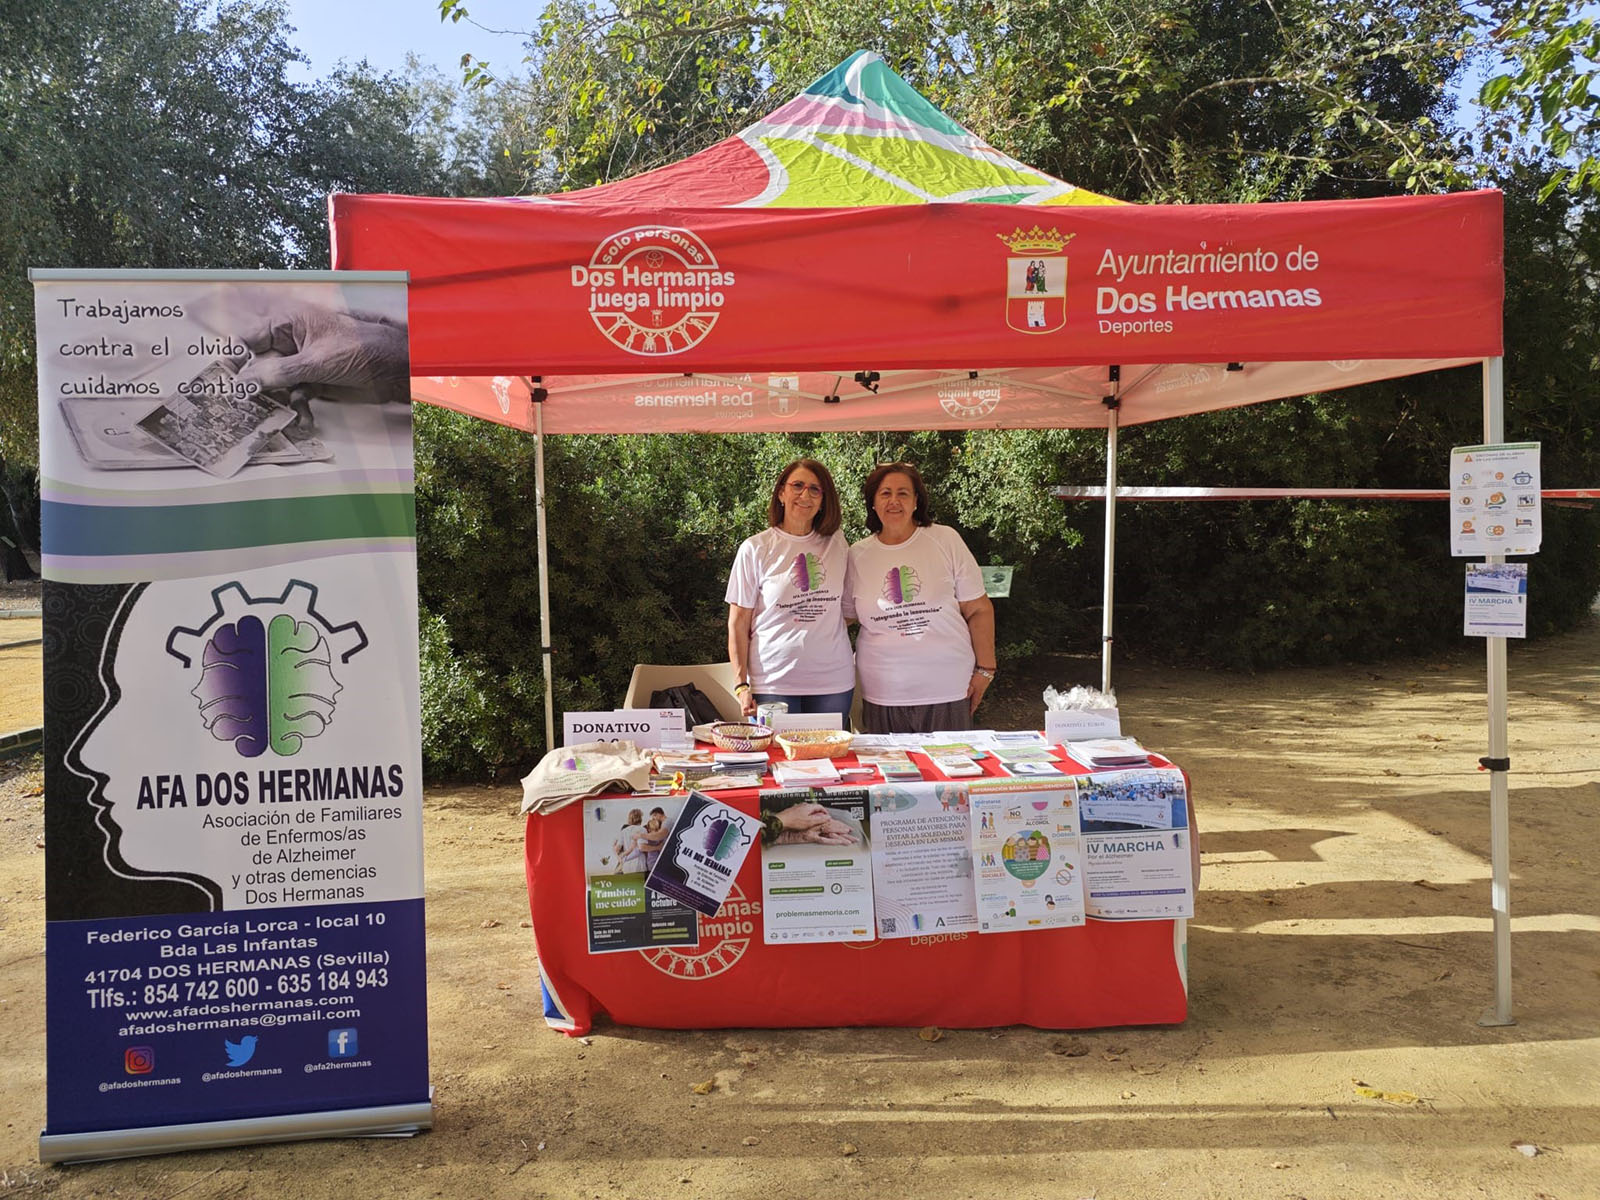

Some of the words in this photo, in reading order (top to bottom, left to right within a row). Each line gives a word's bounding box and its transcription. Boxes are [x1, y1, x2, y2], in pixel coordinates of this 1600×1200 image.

[602, 236, 632, 265] solo
[635, 229, 705, 264] personas
[1096, 246, 1278, 282] Ayuntamiento
[1286, 244, 1319, 271] de
[571, 265, 615, 287] Dos
[622, 265, 736, 287] Hermanas
[588, 287, 650, 312] juega
[657, 286, 725, 312] limpio
[1096, 287, 1157, 315] Dos
[1166, 285, 1323, 312] Hermanas
[57, 298, 184, 324] Trabajamos
[1099, 318, 1173, 336] Deportes
[60, 337, 134, 357] contra
[152, 336, 169, 356] el
[187, 336, 253, 360] olvido,
[60, 374, 160, 396] cuidamos
[177, 376, 258, 399] contigo
[573, 723, 651, 734] DONATIVO
[137, 775, 188, 810] AFA
[196, 771, 250, 807] DOS
[259, 764, 404, 804] HERMANAS
[202, 810, 290, 829] Asociación
[296, 808, 315, 824] de
[321, 806, 402, 823] Familiares
[880, 819, 917, 827] PROGRAMA
[928, 814, 961, 823] ATENCIÓN
[241, 831, 261, 846] de
[267, 826, 366, 845] Enfermos/as
[882, 826, 917, 834] PERSONAS
[886, 833, 910, 841] EVITAR
[252, 850, 273, 865] de
[276, 847, 356, 864] Alzheimer
[1087, 844, 1100, 854] IV
[1103, 840, 1165, 853] MARCHA
[682, 847, 693, 858] AFA
[693, 852, 704, 863] DOS
[704, 857, 732, 877] HERMANAS
[232, 875, 241, 889] y
[246, 869, 286, 885] otras
[291, 865, 377, 882] demencias
[246, 889, 277, 905] Dos
[283, 884, 365, 902] Hermanas
[595, 887, 636, 898] También
[651, 899, 677, 908] octubre
[595, 901, 610, 909] me
[776, 909, 860, 919] problemasmemoria.com
[87, 927, 172, 945] Federico
[178, 921, 239, 939] García
[245, 918, 298, 934] Lorca
[316, 914, 359, 929] local
[366, 912, 386, 927] 10
[699, 917, 753, 940] impio
[911, 932, 968, 947] Deportes
[160, 943, 198, 958] Bda
[204, 941, 237, 956] Las
[244, 936, 318, 953] Infantas
[84, 968, 142, 985] 41704
[149, 964, 191, 980] DOS
[197, 955, 311, 977] HERMANAS
[316, 950, 390, 971] (Sevilla)
[87, 988, 137, 1009] Tlfs.:
[144, 983, 179, 1004] 854
[185, 980, 219, 1001] 742
[225, 977, 260, 998] 600
[277, 973, 312, 994] 635
[317, 970, 350, 991] 184
[356, 968, 389, 987] 943
[126, 994, 354, 1021] www.afadoshermanas.com
[118, 1008, 361, 1037] afadoshermanas@gmail.com
[202, 1067, 283, 1082] @afadoshermanas
[304, 1059, 372, 1073] @afa2hermanas
[99, 1077, 181, 1092] @afadoshermanas
